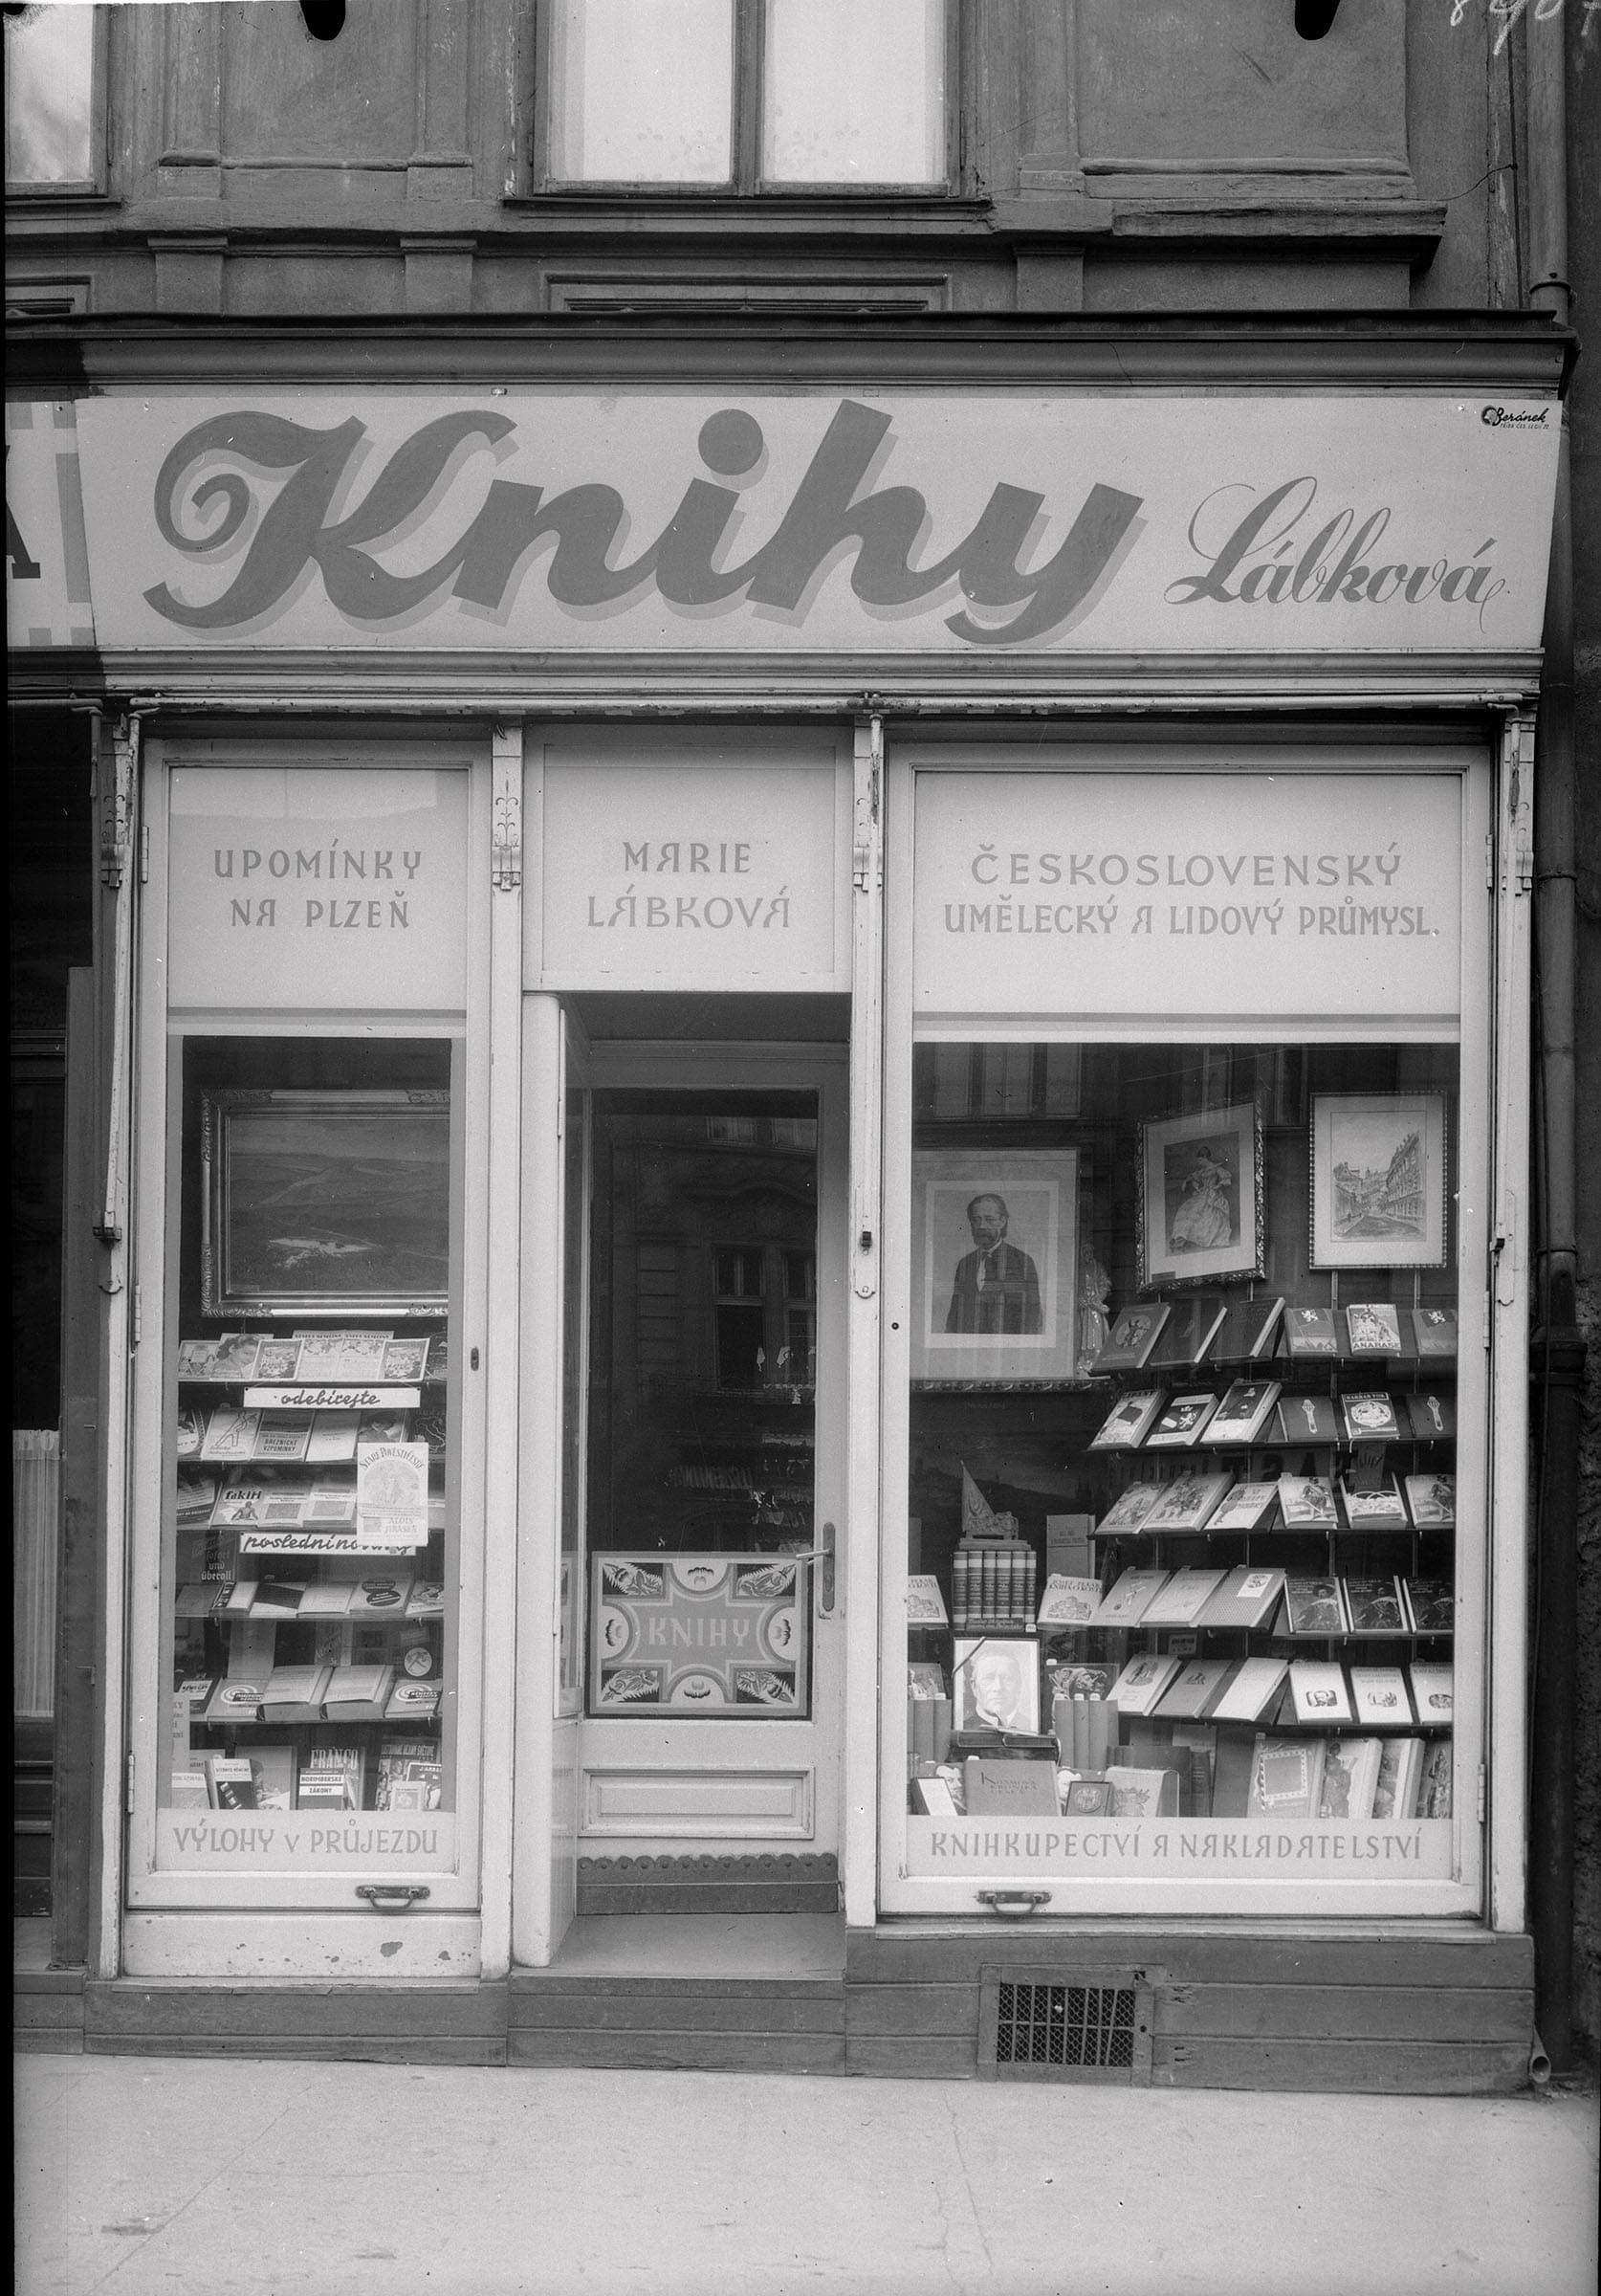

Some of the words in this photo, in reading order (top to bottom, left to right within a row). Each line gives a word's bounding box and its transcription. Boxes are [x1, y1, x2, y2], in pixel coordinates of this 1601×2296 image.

[1491, 407, 1549, 427] Beránek
[143, 396, 1142, 652] Knihy
[1163, 475, 1507, 633] Lábková
[213, 838, 422, 879] UPOMÍNKY
[622, 841, 751, 873] MARIE
[971, 841, 1402, 887] ČESKOSLOVENSKÝ
[230, 898, 276, 927] NA
[305, 891, 409, 929] PLZEŇ
[587, 883, 790, 929] LÁBKOVÁ
[944, 894, 1118, 934] UMĚLECKÝ
[1130, 905, 1153, 935] A
[1170, 897, 1284, 936] LIDOVÝ
[1299, 895, 1440, 937] PRŮMYSL.
[243, 1533, 335, 1553] poslední
[647, 1617, 750, 1647] KNIHY
[172, 1818, 274, 1853] VÝLOHY
[310, 1818, 437, 1855] PRŮJEZDU
[931, 1824, 1142, 1858] KNIHKUPECTVÍ
[1152, 1834, 1169, 1858] A
[1180, 1826, 1423, 1860] NAKLADATELSTVÍ
